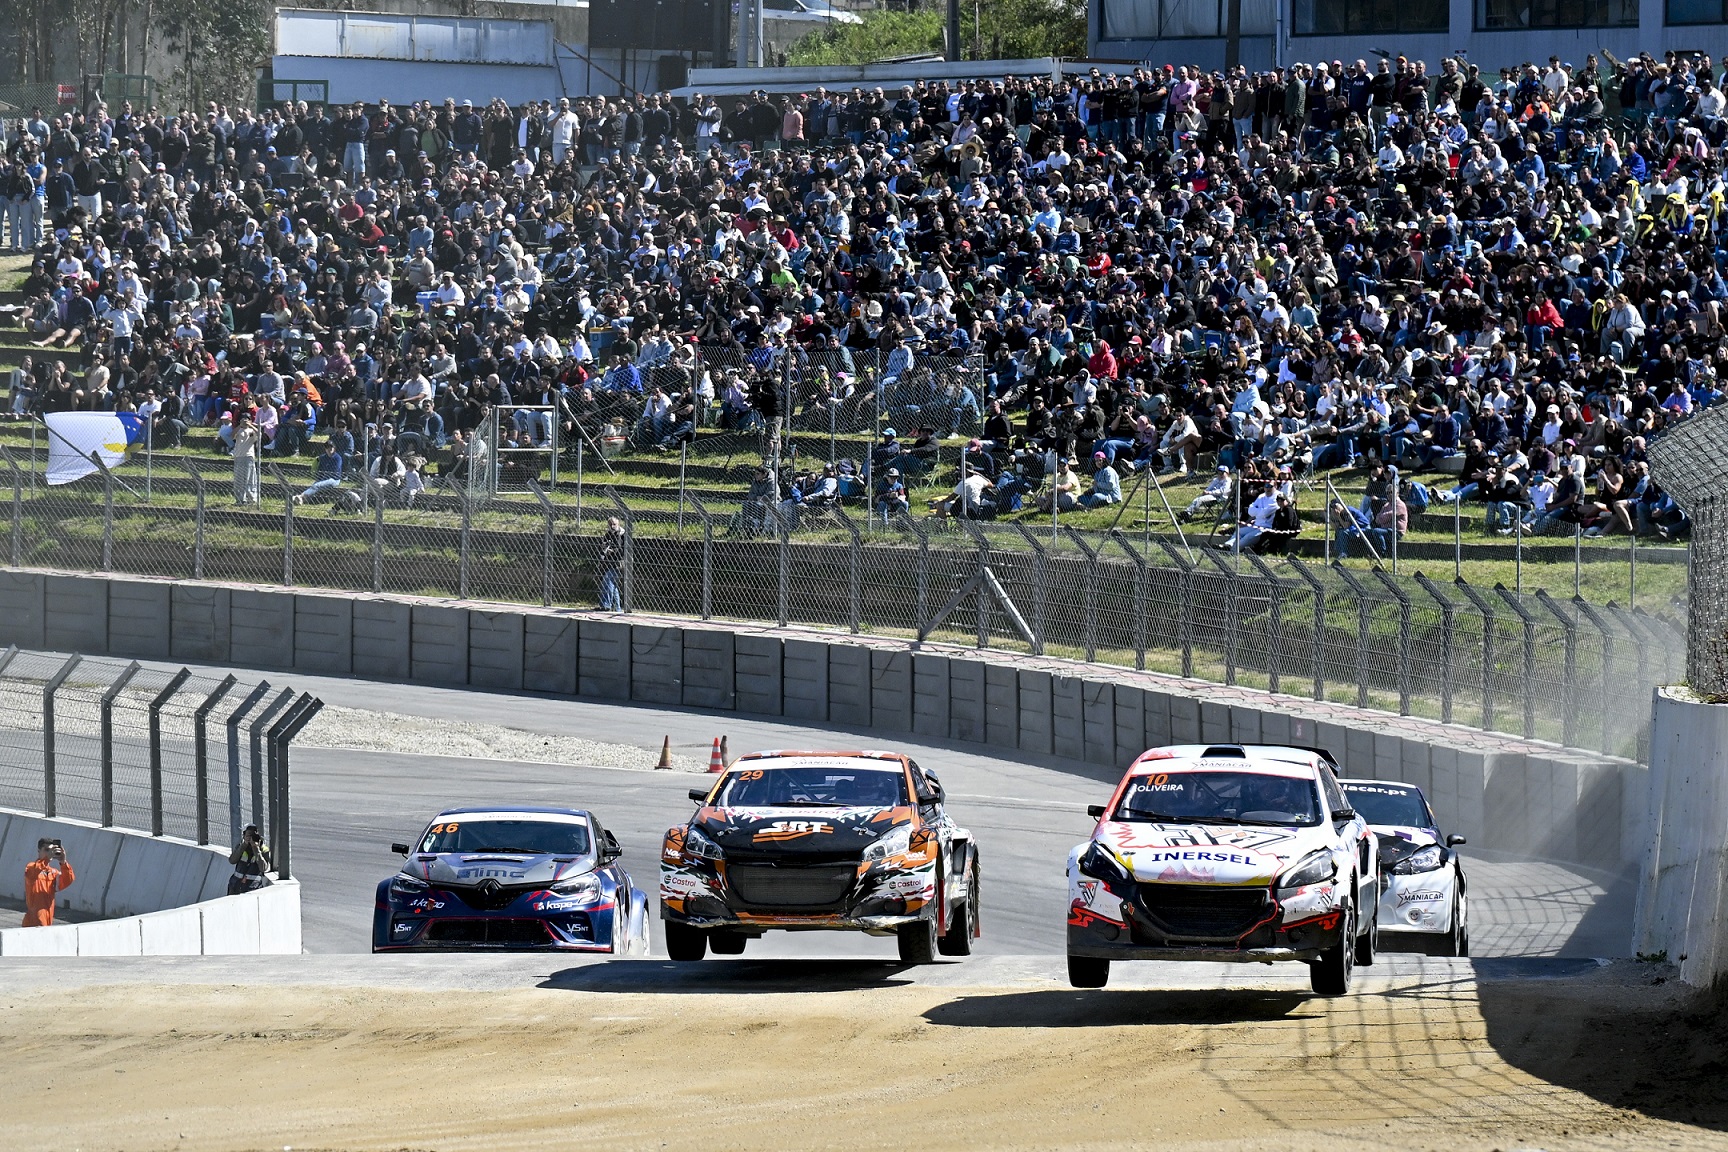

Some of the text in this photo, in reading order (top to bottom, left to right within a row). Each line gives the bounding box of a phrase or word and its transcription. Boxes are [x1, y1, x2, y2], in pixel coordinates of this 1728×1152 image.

[738, 770, 764, 780] 29
[1146, 773, 1169, 786] 10
[1137, 784, 1184, 792] OLIVEIRA
[431, 823, 460, 834] 46
[759, 821, 828, 833] SRT
[1152, 851, 1257, 866] INERSEL
[671, 877, 697, 888] Castrol
[897, 880, 922, 888] Castrol
[1404, 893, 1444, 901] MANIACAR
